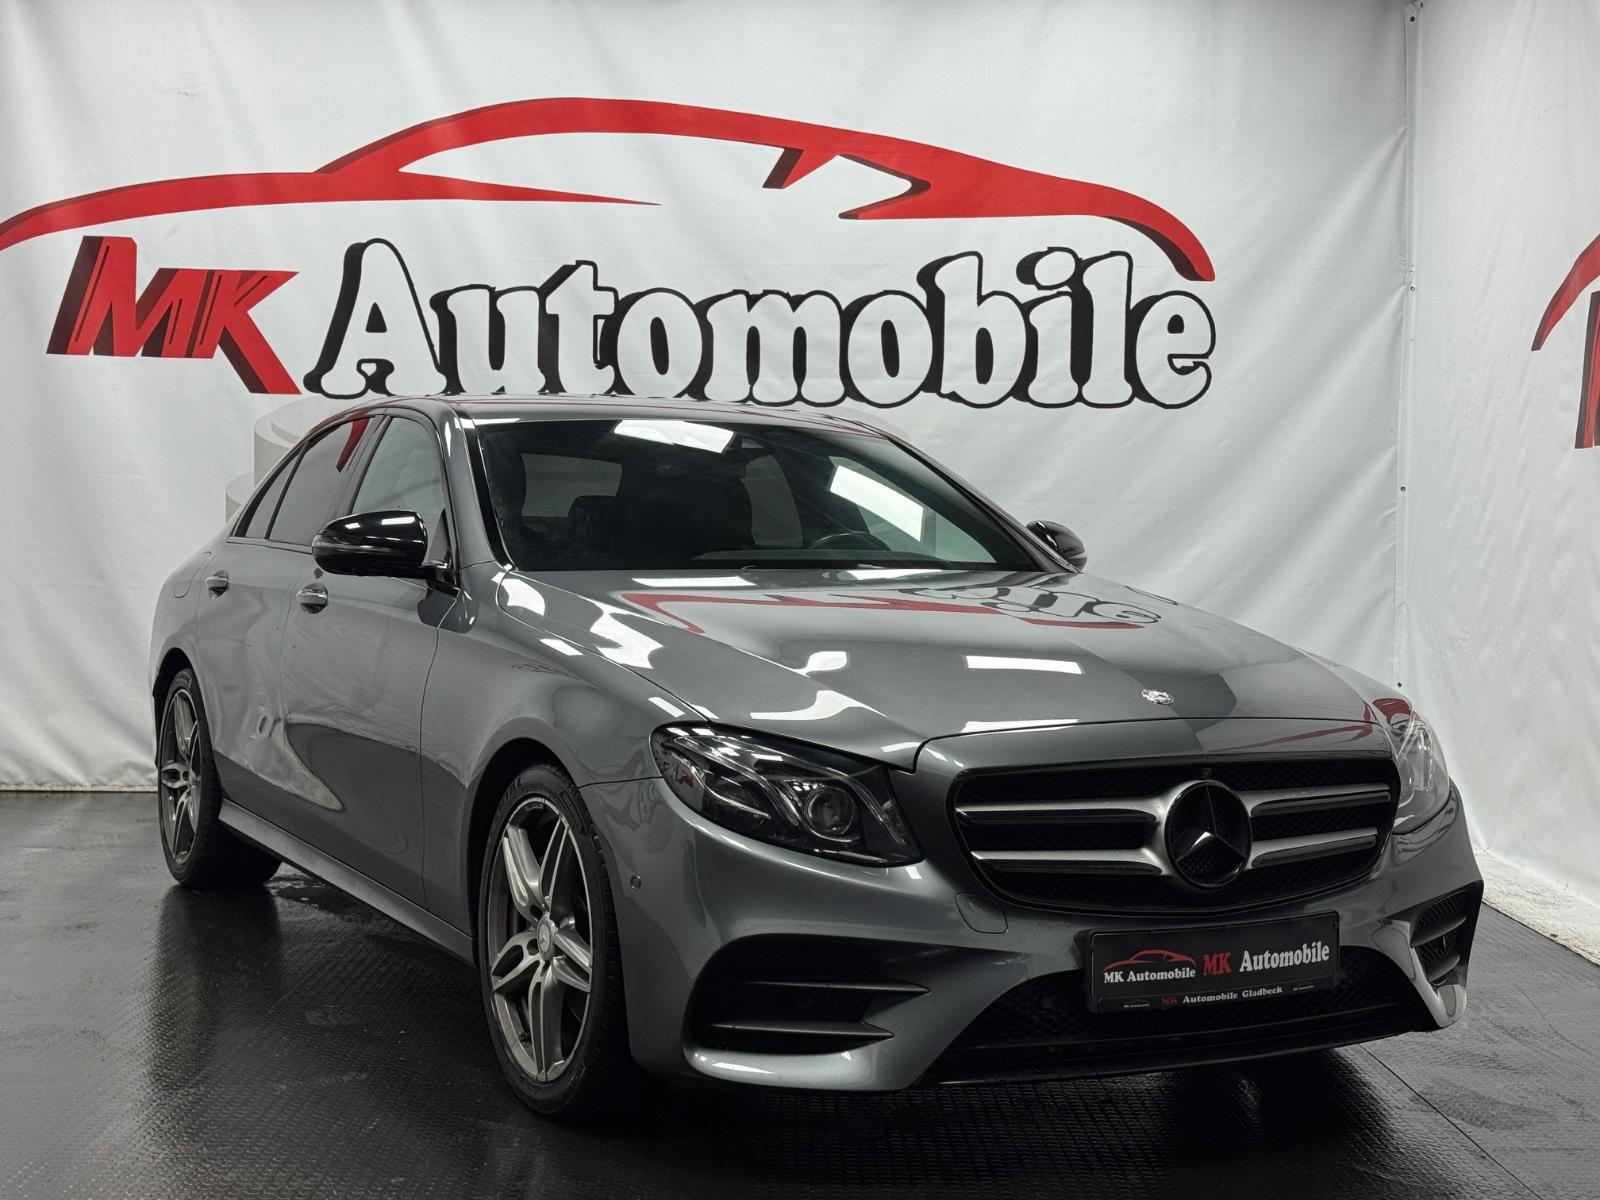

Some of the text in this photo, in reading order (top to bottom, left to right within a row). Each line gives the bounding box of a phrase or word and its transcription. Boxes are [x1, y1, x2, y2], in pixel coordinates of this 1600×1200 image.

[47, 236, 1216, 409] MK Automobile
[1202, 941, 1330, 976] MK Automobile
[1103, 967, 1196, 984] MK Automobile
[1182, 991, 1238, 1004] Automobile
[1242, 986, 1283, 998] Gladbeck
